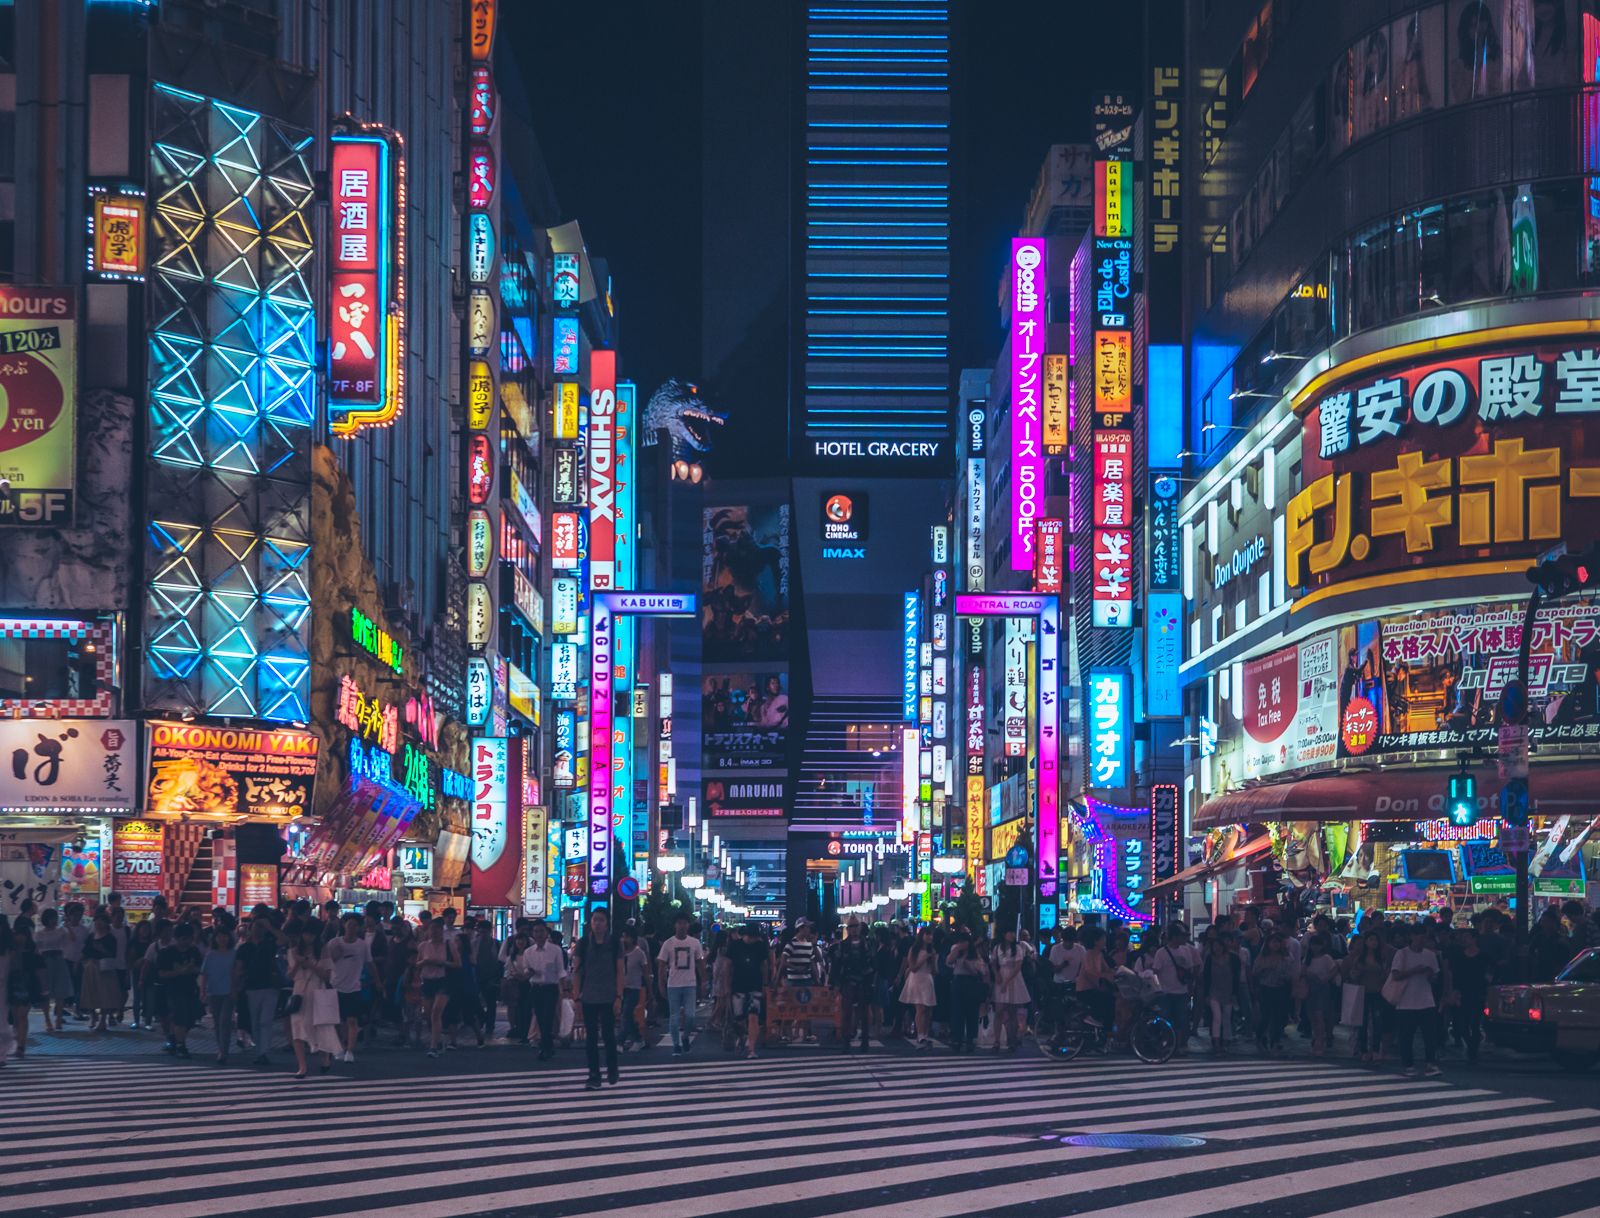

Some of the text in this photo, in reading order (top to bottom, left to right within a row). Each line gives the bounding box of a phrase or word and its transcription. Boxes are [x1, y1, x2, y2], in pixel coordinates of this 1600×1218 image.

[1108, 165, 1120, 221] Garam
[340, 170, 369, 262] 居酒屋
[108, 221, 130, 256] 虎の子
[1100, 224, 1127, 234] ガラム
[1096, 240, 1131, 249] New Club
[1097, 258, 1114, 312] Elle de
[1114, 250, 1130, 299] Castle
[332, 284, 375, 360] つぼ八
[1105, 316, 1122, 325] 7F
[5, 327, 55, 352] 120分
[1018, 318, 1038, 458] オープンスペース
[1319, 349, 1600, 459] 驚安の殿堂
[12, 416, 45, 432] yen
[969, 409, 985, 451] Booth
[1104, 414, 1123, 426] 6F
[590, 389, 614, 523] SHIDAX
[815, 442, 939, 456] HOTEL GRACERY
[973, 464, 981, 511] ネットカフェ
[1103, 459, 1124, 525] 居楽屋
[19, 493, 65, 521] 5F
[825, 524, 849, 532] TOHO
[823, 549, 866, 558] IMAX
[972, 528, 981, 559] カプセル
[1214, 536, 1265, 590] Don Quijote
[1012, 601, 1042, 609] ROAD
[1383, 621, 1427, 634] Attraction
[1430, 616, 1454, 628] built
[1456, 615, 1473, 626] for
[1475, 615, 1482, 623] a
[1485, 612, 1508, 622] real
[1511, 611, 1526, 622] sp
[471, 641, 483, 651] 1F
[905, 597, 918, 716] 747 カラオケランド
[1155, 638, 1165, 675] STAGE
[1164, 637, 1175, 669] IDOL
[1303, 642, 1329, 657] インスパイヤ
[1258, 676, 1281, 710] 免税
[471, 712, 484, 722] B1
[1258, 709, 1281, 727] Tax Free
[1346, 706, 1374, 720] レーザー
[556, 714, 570, 748] 海の家
[704, 731, 785, 746] トランスフォーマー
[1095, 677, 1121, 782] カラオケ
[1346, 720, 1373, 734] ギミック
[1350, 733, 1366, 746] 追加
[154, 726, 319, 755] OKONOMI YAKI
[593, 637, 608, 852] GODZILLA ROAD
[1042, 658, 1056, 839] ゴジラロード
[219, 762, 245, 771] Drinks
[246, 763, 258, 771] for
[258, 764, 265, 772] 2
[266, 765, 289, 774] hours
[221, 752, 249, 762] dinner
[249, 754, 265, 763] with
[719, 757, 733, 767] 8.4
[969, 757, 983, 765] 4F
[969, 765, 983, 774] 3F
[476, 745, 493, 820] トラノコ
[730, 784, 783, 798] MARUHAN
[1375, 795, 1419, 812] Don
[572, 831, 581, 856] 牛かつ
[1156, 789, 1174, 873] カラオケ
[843, 843, 873, 854] TOHO
[1125, 838, 1144, 907] カラオケ
[528, 880, 542, 894] 集
